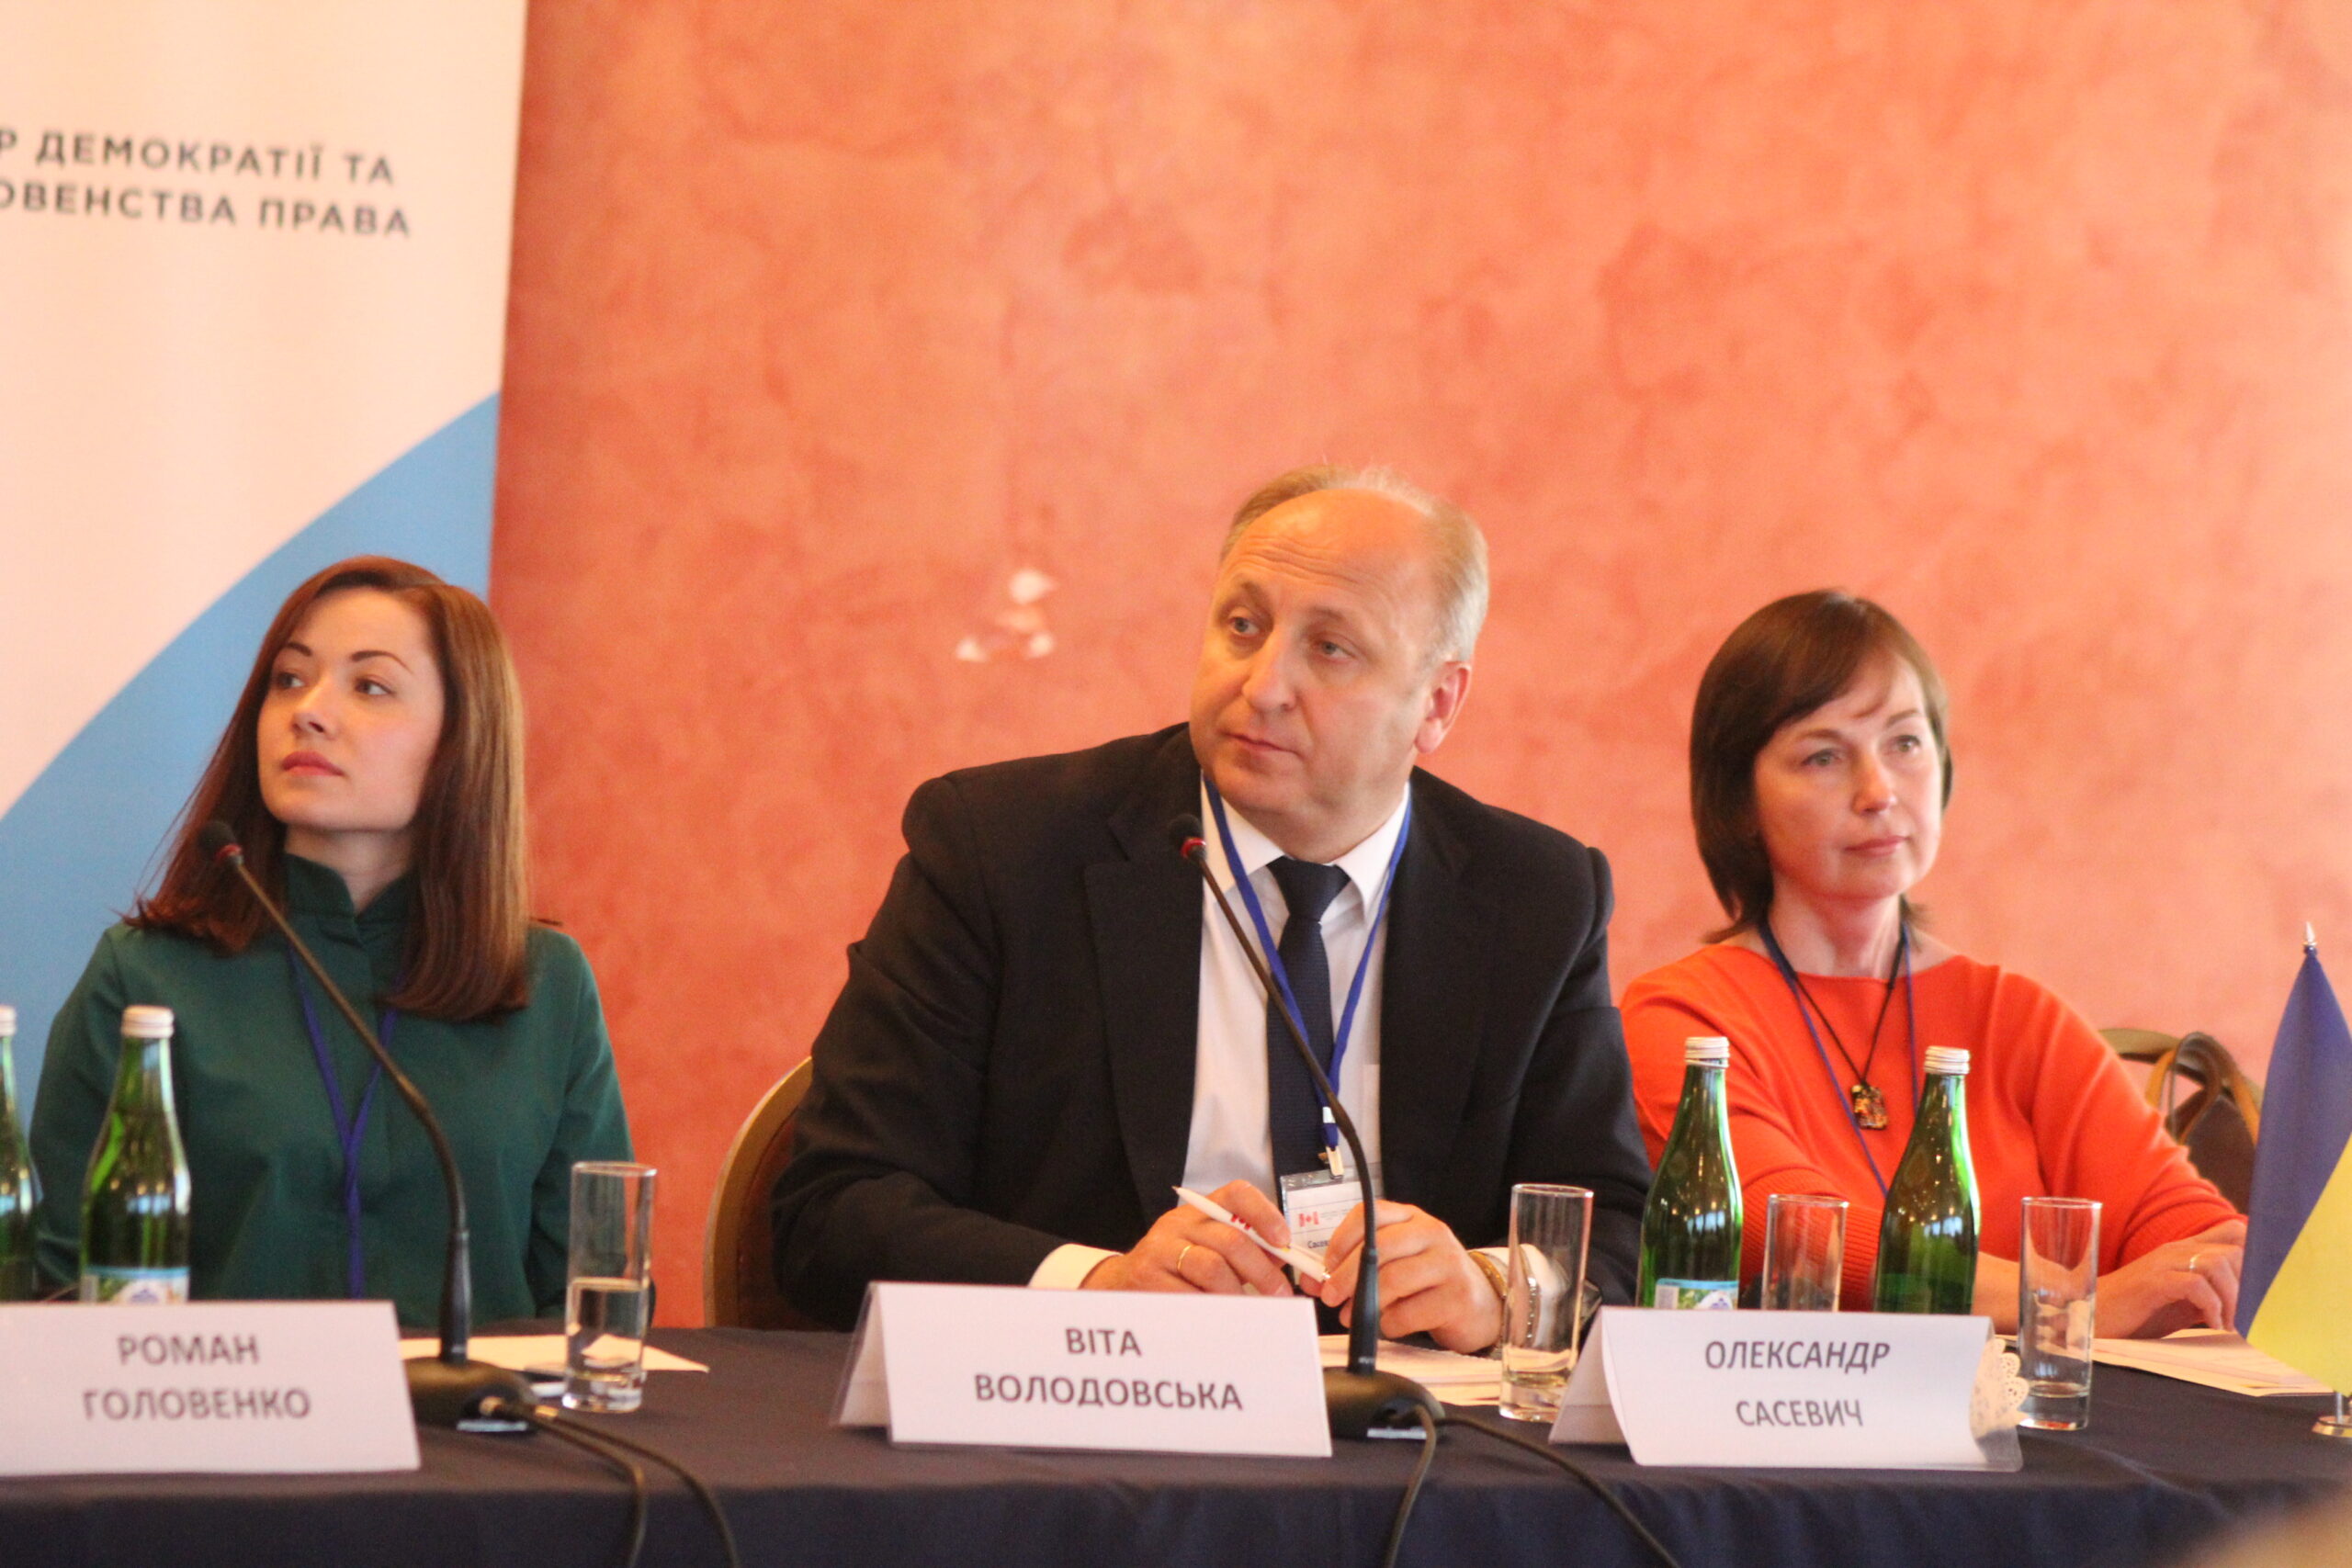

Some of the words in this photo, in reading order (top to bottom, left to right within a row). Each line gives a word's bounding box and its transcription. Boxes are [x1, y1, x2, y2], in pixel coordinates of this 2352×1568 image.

[35, 130, 322, 180] ДЕМОКРАТІЇ
[343, 153, 394, 185] ТА
[258, 197, 411, 237] ПРАВА
[118, 1334, 260, 1365] РОМАН
[1066, 1327, 1142, 1357] ВІТА
[1704, 1340, 1891, 1374] ОЛЕКСАНДР
[83, 1387, 311, 1420] ГОЛОВЕНКО
[974, 1373, 1243, 1411] ВОЛОДОВСЬКА
[1736, 1399, 1864, 1427] САСЕВИЧ
